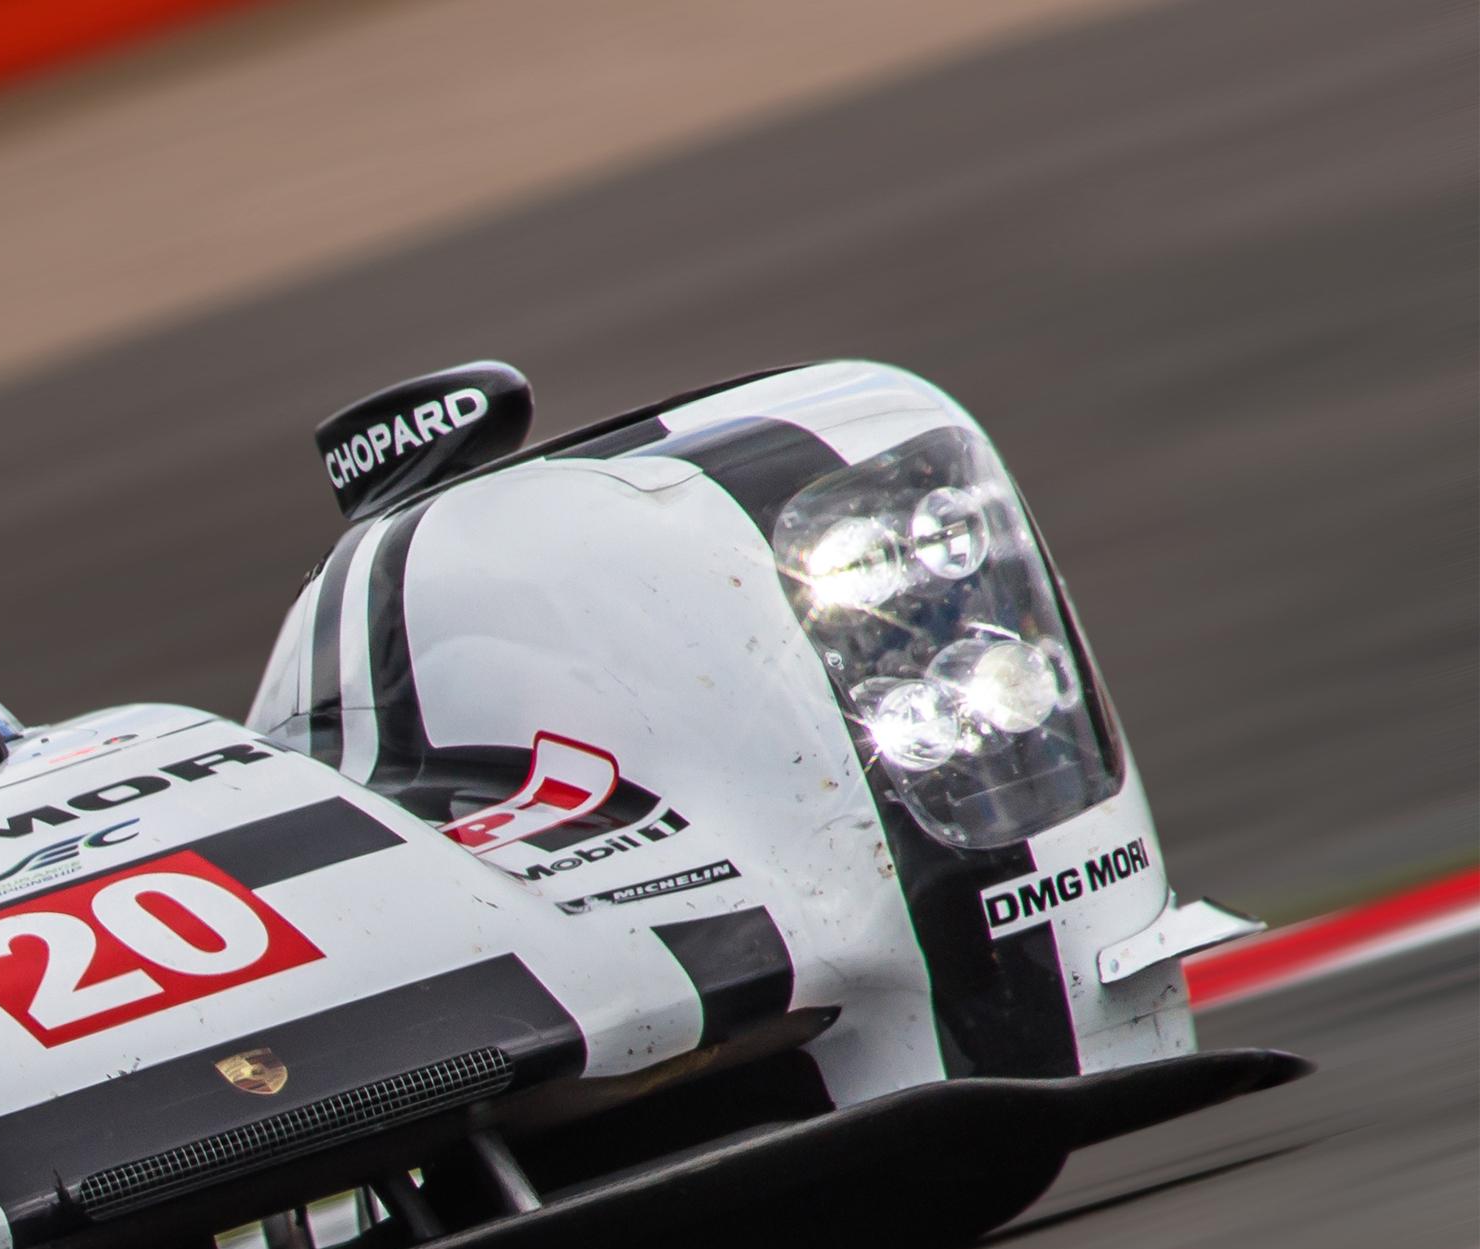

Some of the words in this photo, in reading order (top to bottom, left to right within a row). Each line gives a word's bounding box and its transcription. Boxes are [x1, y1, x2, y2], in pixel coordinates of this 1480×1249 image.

[326, 387, 488, 489] CHOPARD
[520, 834, 641, 881] Mobil
[613, 862, 731, 901] MICHELIN
[985, 867, 1084, 928] DMG
[1085, 837, 1150, 892] MORI
